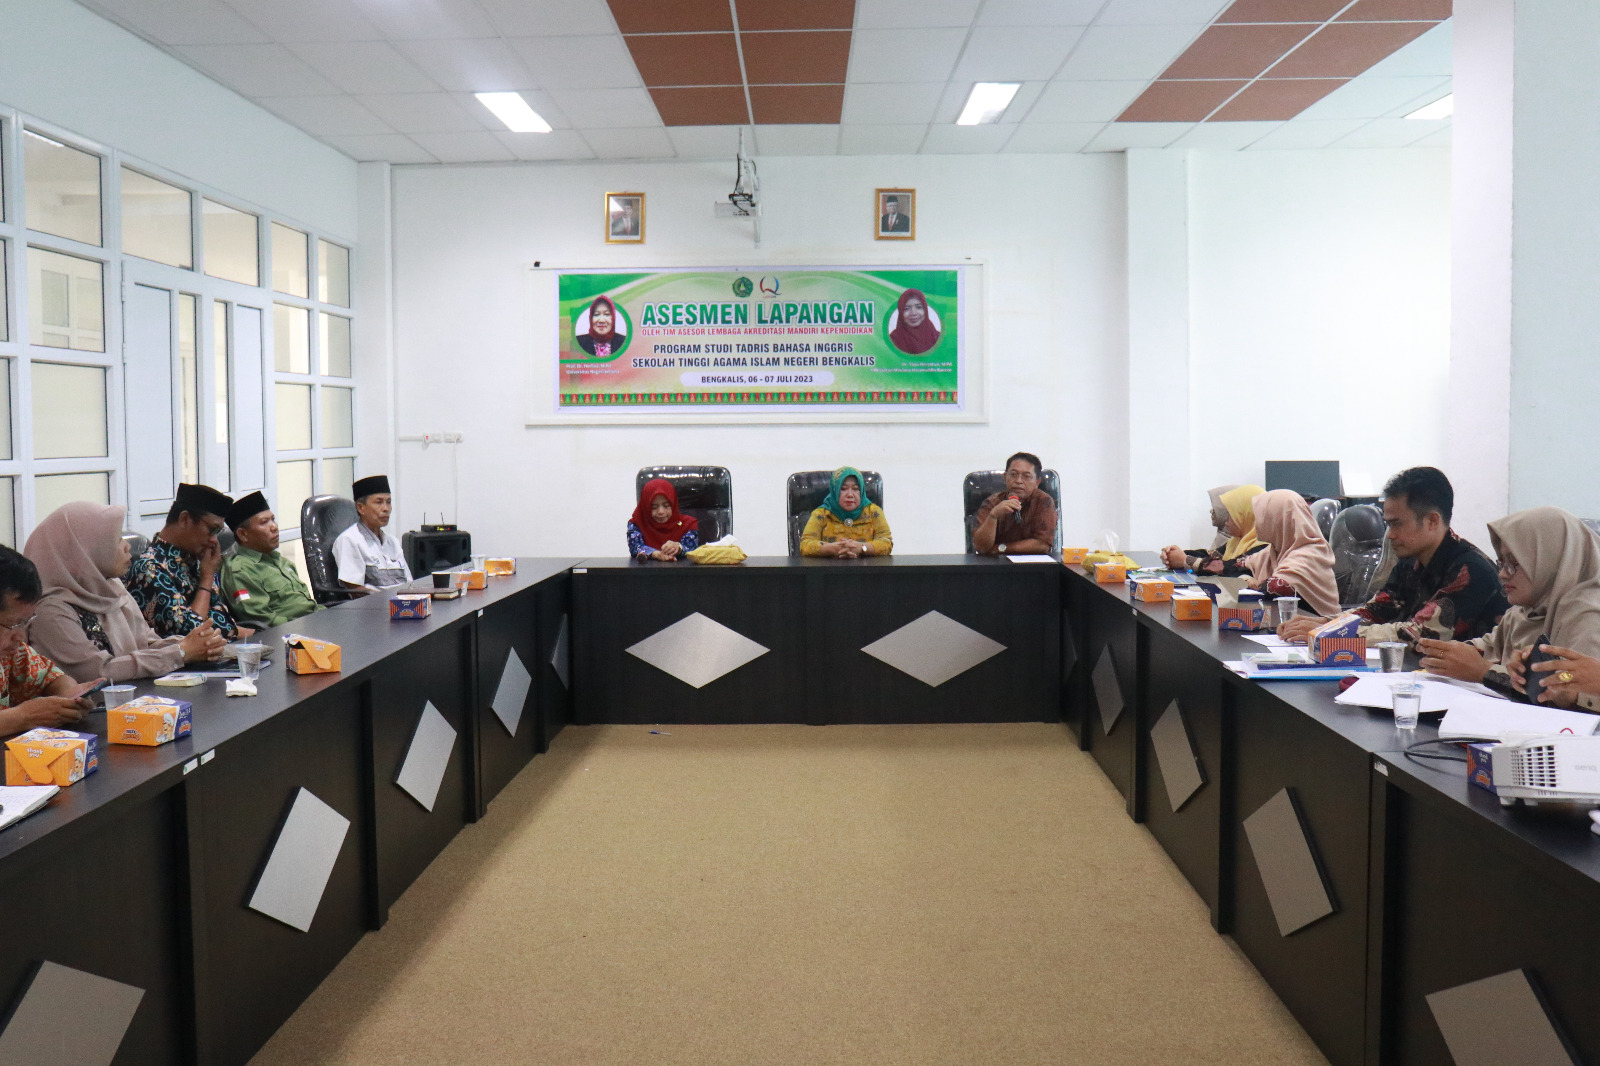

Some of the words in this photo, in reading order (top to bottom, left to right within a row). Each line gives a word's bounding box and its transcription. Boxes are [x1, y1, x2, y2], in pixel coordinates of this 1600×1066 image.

[642, 302, 748, 326] ASESMEN
[757, 302, 874, 325] LAPANGAN
[654, 344, 700, 354] PROGRAM
[704, 344, 732, 353] STUDI
[736, 344, 770, 353] TADRIS
[773, 343, 811, 352] BAHASA
[814, 343, 853, 352] INGGRIS
[632, 358, 675, 367] SEKOLAH
[678, 358, 709, 367] TINGGI
[713, 357, 747, 367] AGAMA
[750, 357, 780, 366] ISLAM
[784, 357, 818, 366] NEGERI
[822, 357, 875, 366] BENGKALIS
[702, 376, 746, 384] BENGKALIS,
